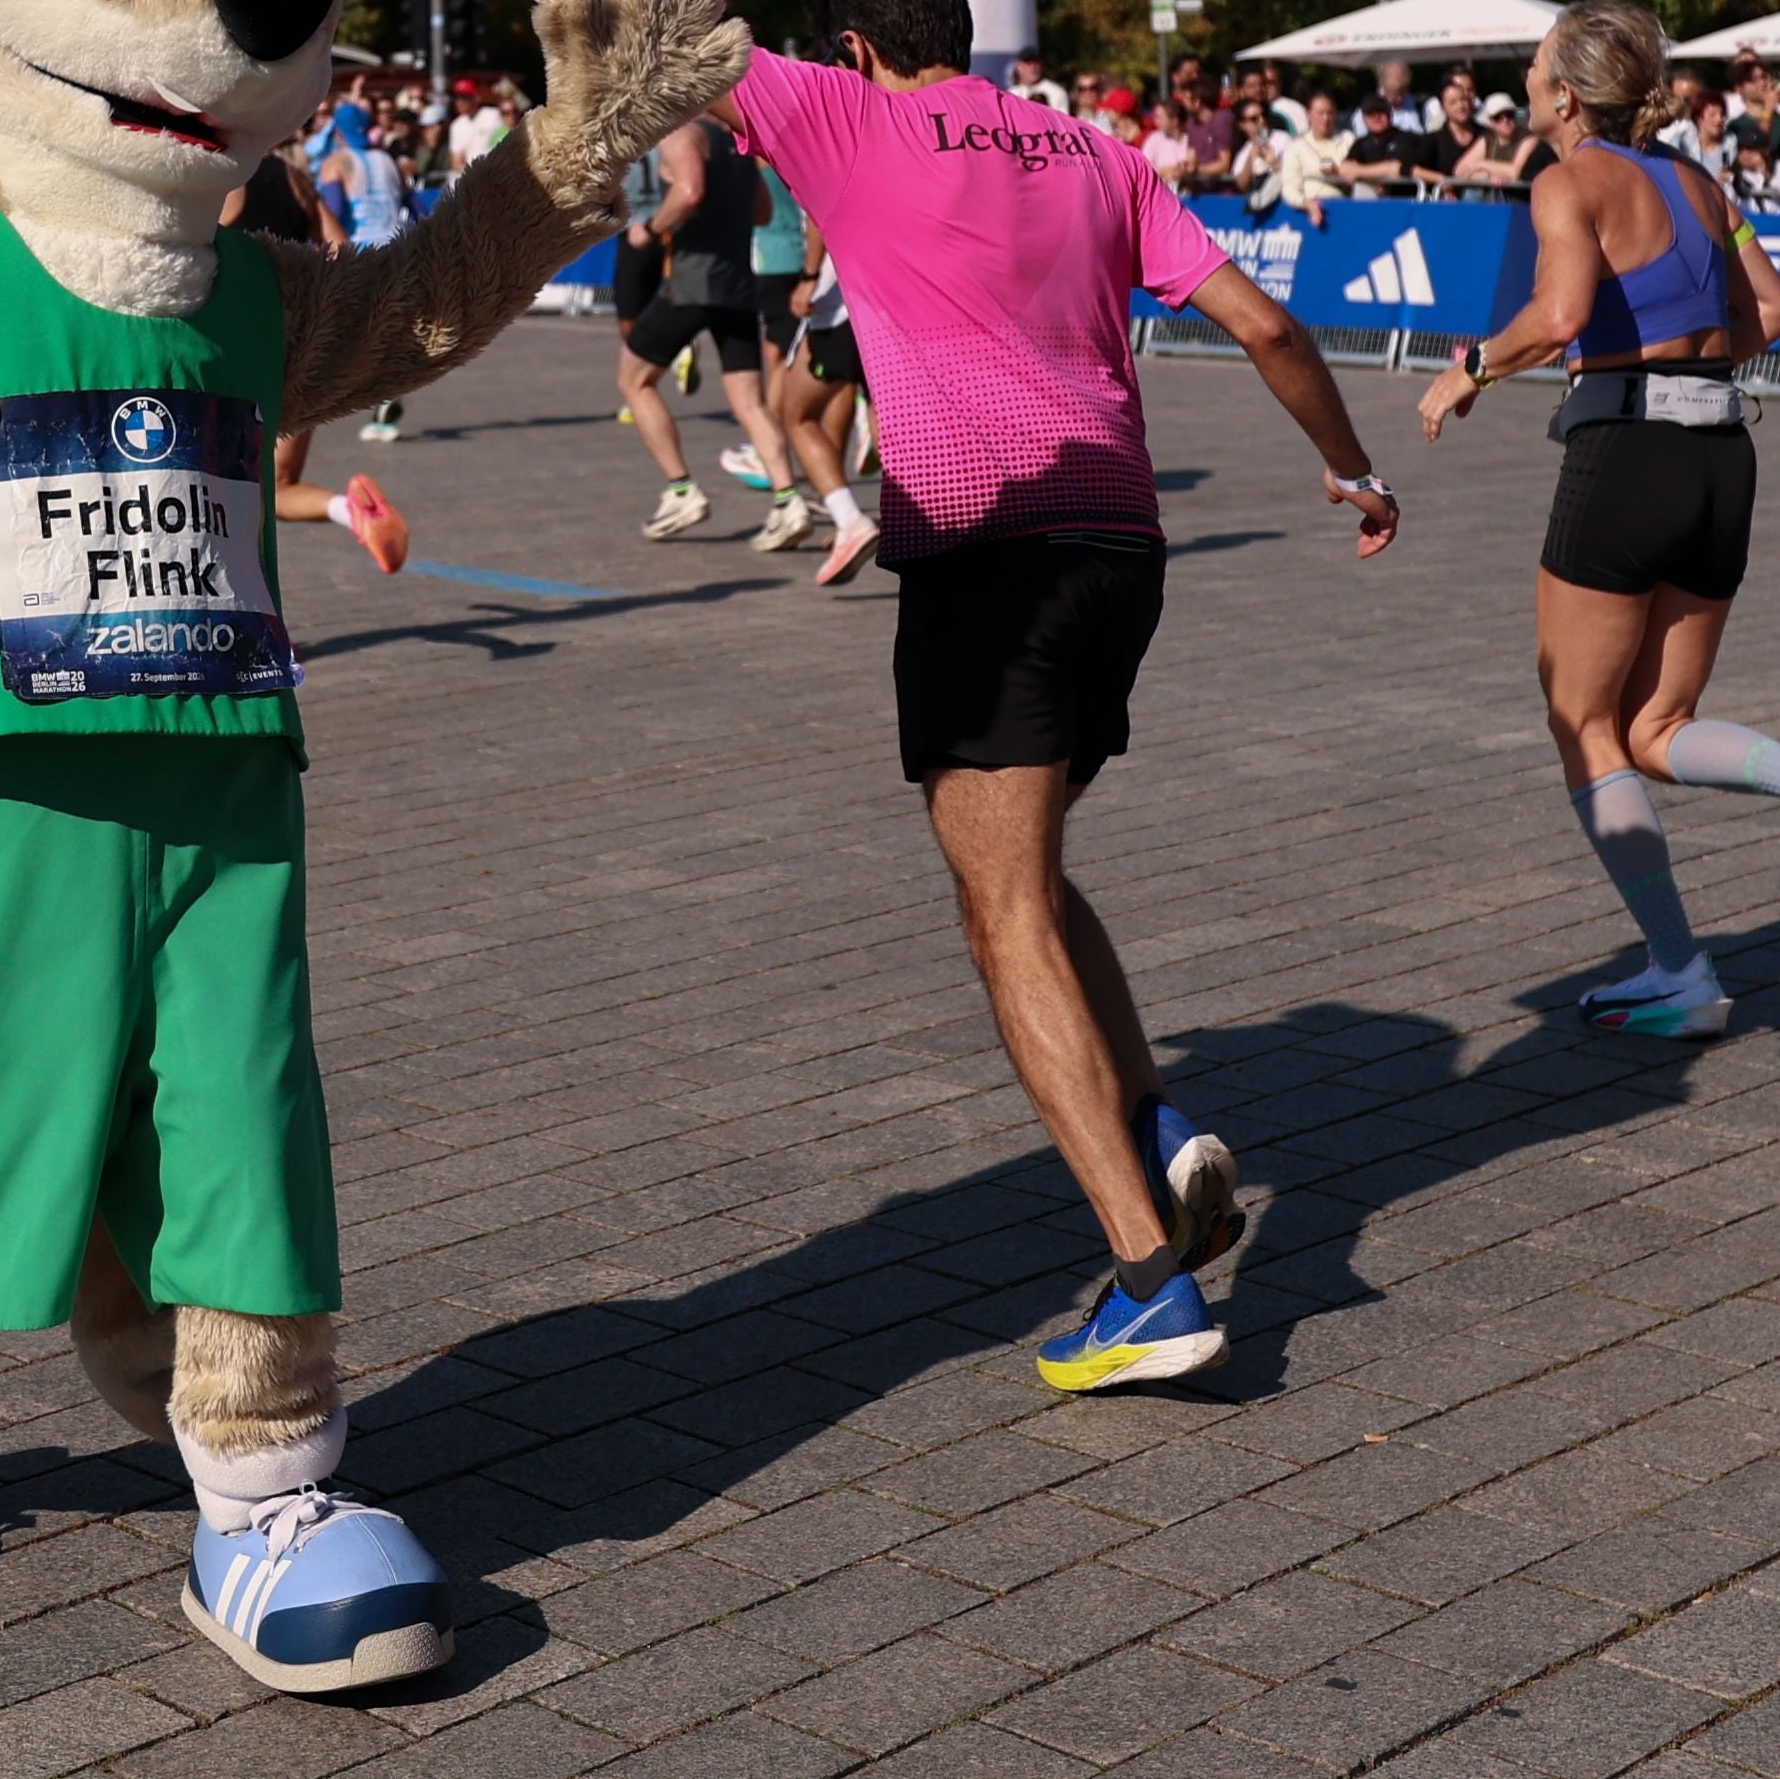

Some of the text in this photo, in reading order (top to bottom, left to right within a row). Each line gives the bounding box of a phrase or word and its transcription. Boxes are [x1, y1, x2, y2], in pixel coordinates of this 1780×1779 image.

[119, 400, 167, 420] BMW
[37, 484, 229, 539] Fridolin
[87, 548, 221, 600] Flink
[86, 618, 235, 655] zalando
[31, 670, 85, 681] BMW 20
[144, 672, 187, 683] September
[71, 681, 86, 692] 26
